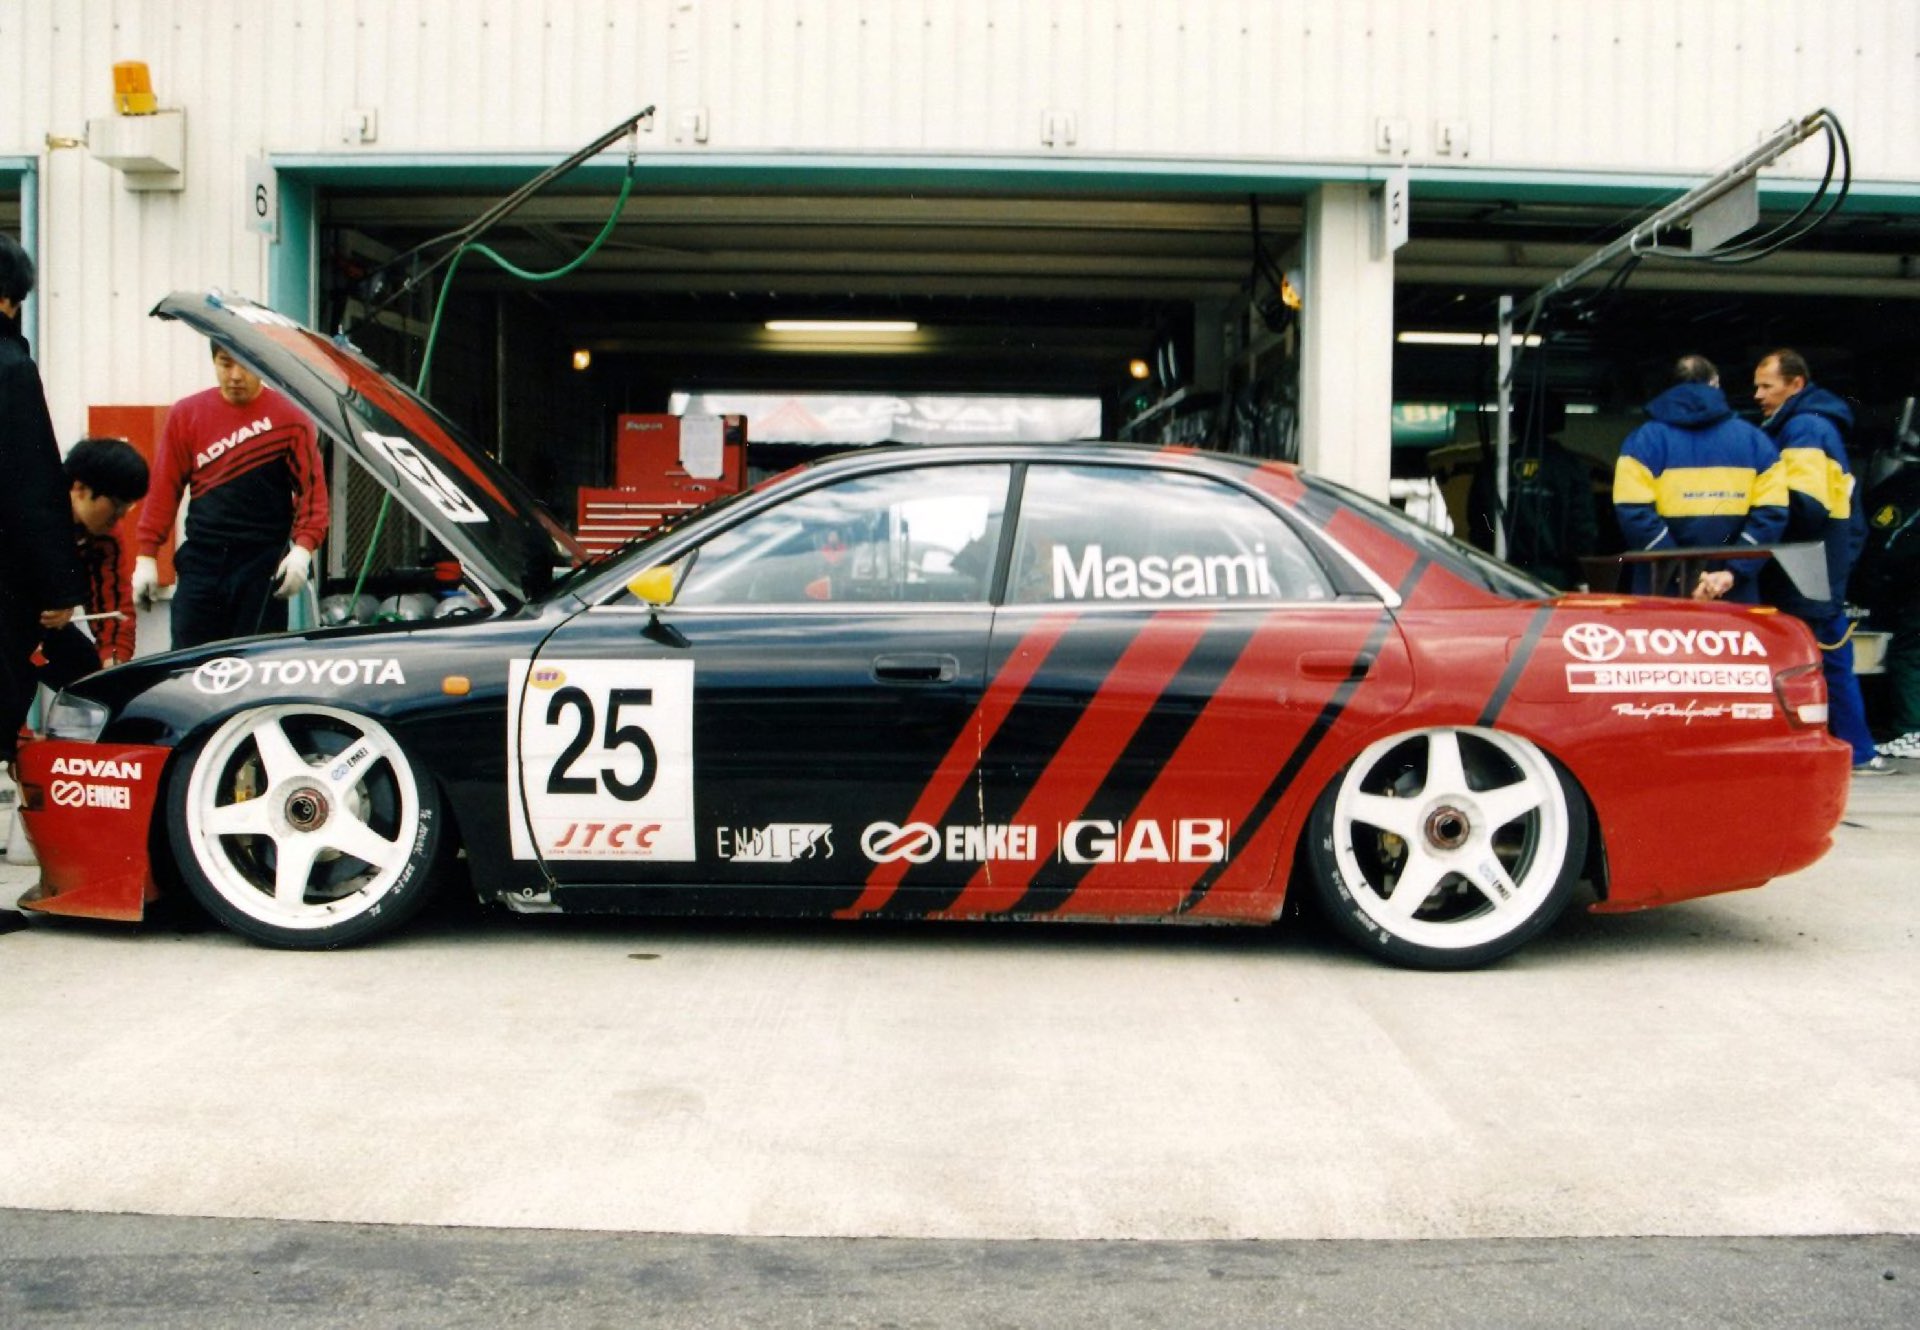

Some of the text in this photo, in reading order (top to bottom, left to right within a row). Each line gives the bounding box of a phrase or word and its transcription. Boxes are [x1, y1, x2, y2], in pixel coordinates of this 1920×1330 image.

[256, 184, 268, 218] 6
[1392, 191, 1400, 226] 5
[196, 416, 273, 469] ADVAN
[1052, 543, 1271, 600] Masami
[1625, 629, 1768, 657] TOYOTA
[258, 659, 405, 685] TOYOTA
[1615, 670, 1769, 687] NIPPONDENSO
[347, 748, 369, 768] ENKEI
[546, 686, 658, 802] 25
[50, 757, 143, 781] ADVAN
[87, 784, 131, 810] ENKEI
[554, 823, 662, 848] JTCC
[717, 826, 834, 862] ENDLESS
[946, 825, 1037, 861] ENKEI
[1057, 818, 1230, 864] GAB
